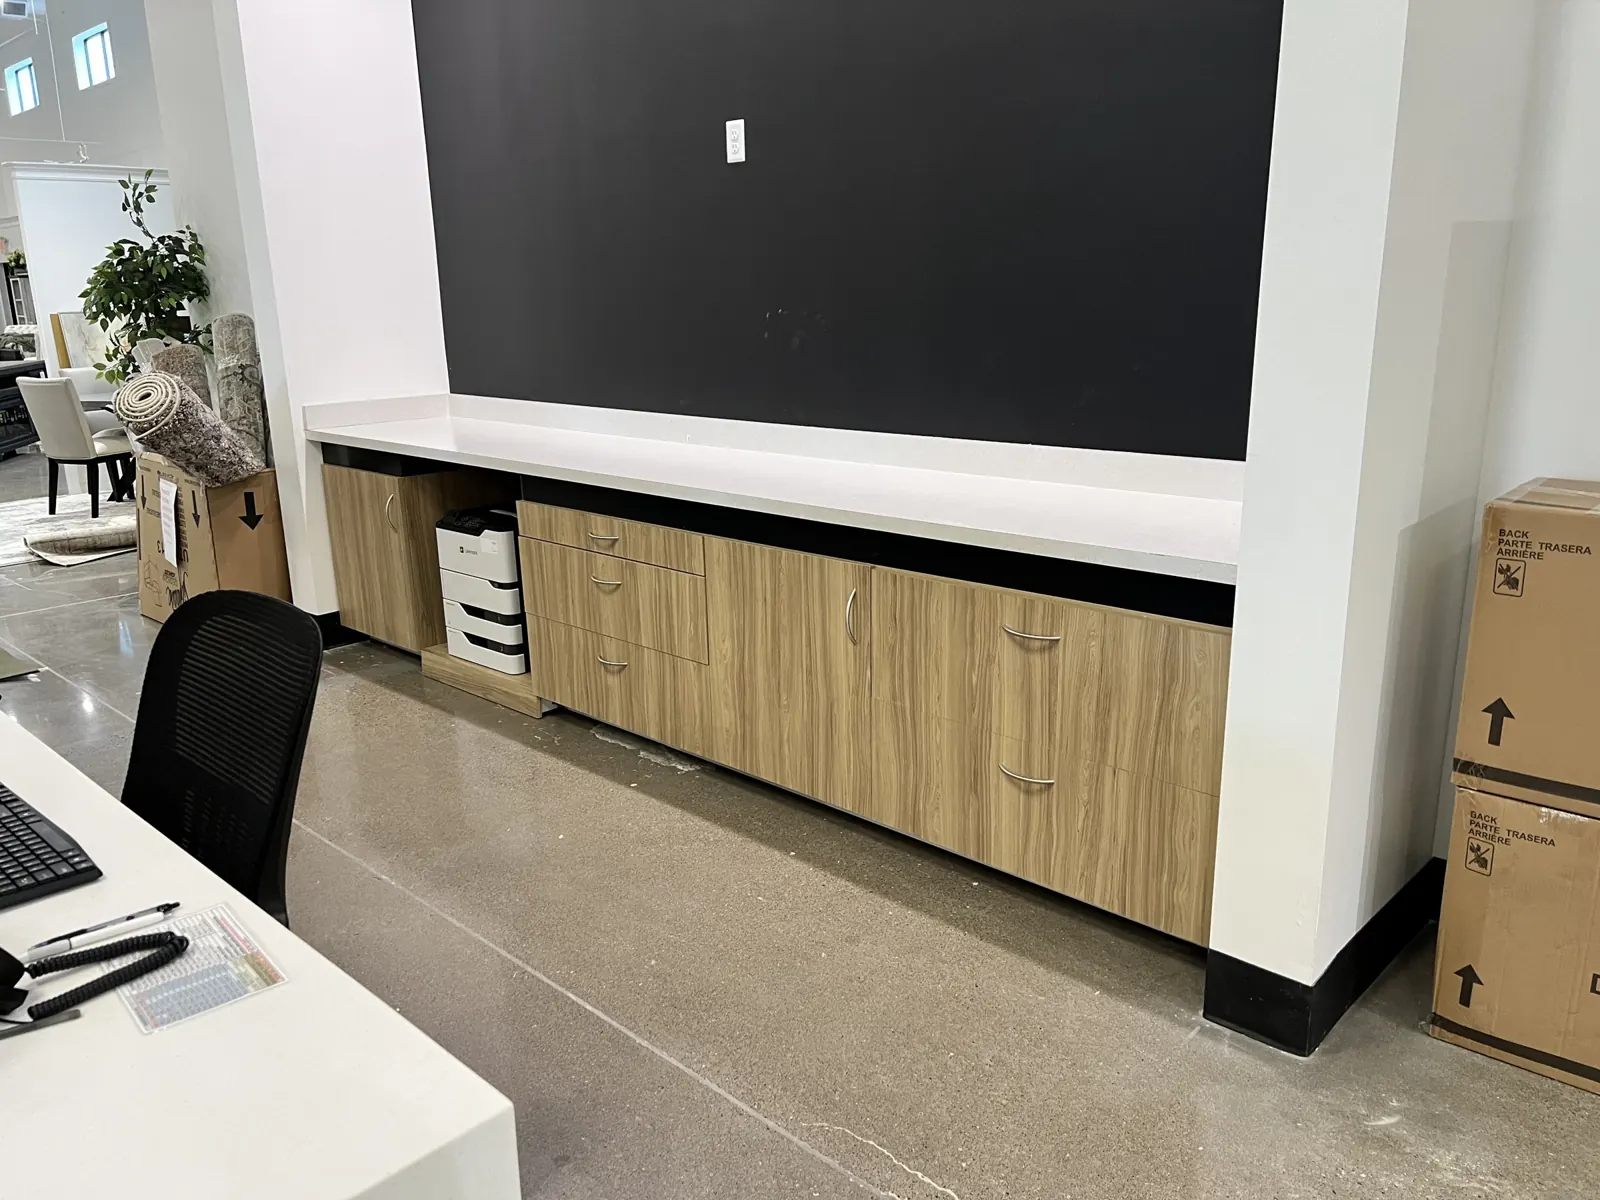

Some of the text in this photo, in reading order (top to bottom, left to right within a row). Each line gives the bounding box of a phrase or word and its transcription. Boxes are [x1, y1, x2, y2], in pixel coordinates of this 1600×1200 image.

[1498, 528, 1530, 539] BACK
[1498, 538, 1592, 555] PARTE TRASERA
[1470, 810, 1498, 825] BACK
[1469, 819, 1556, 847] PARTE TRASERA
